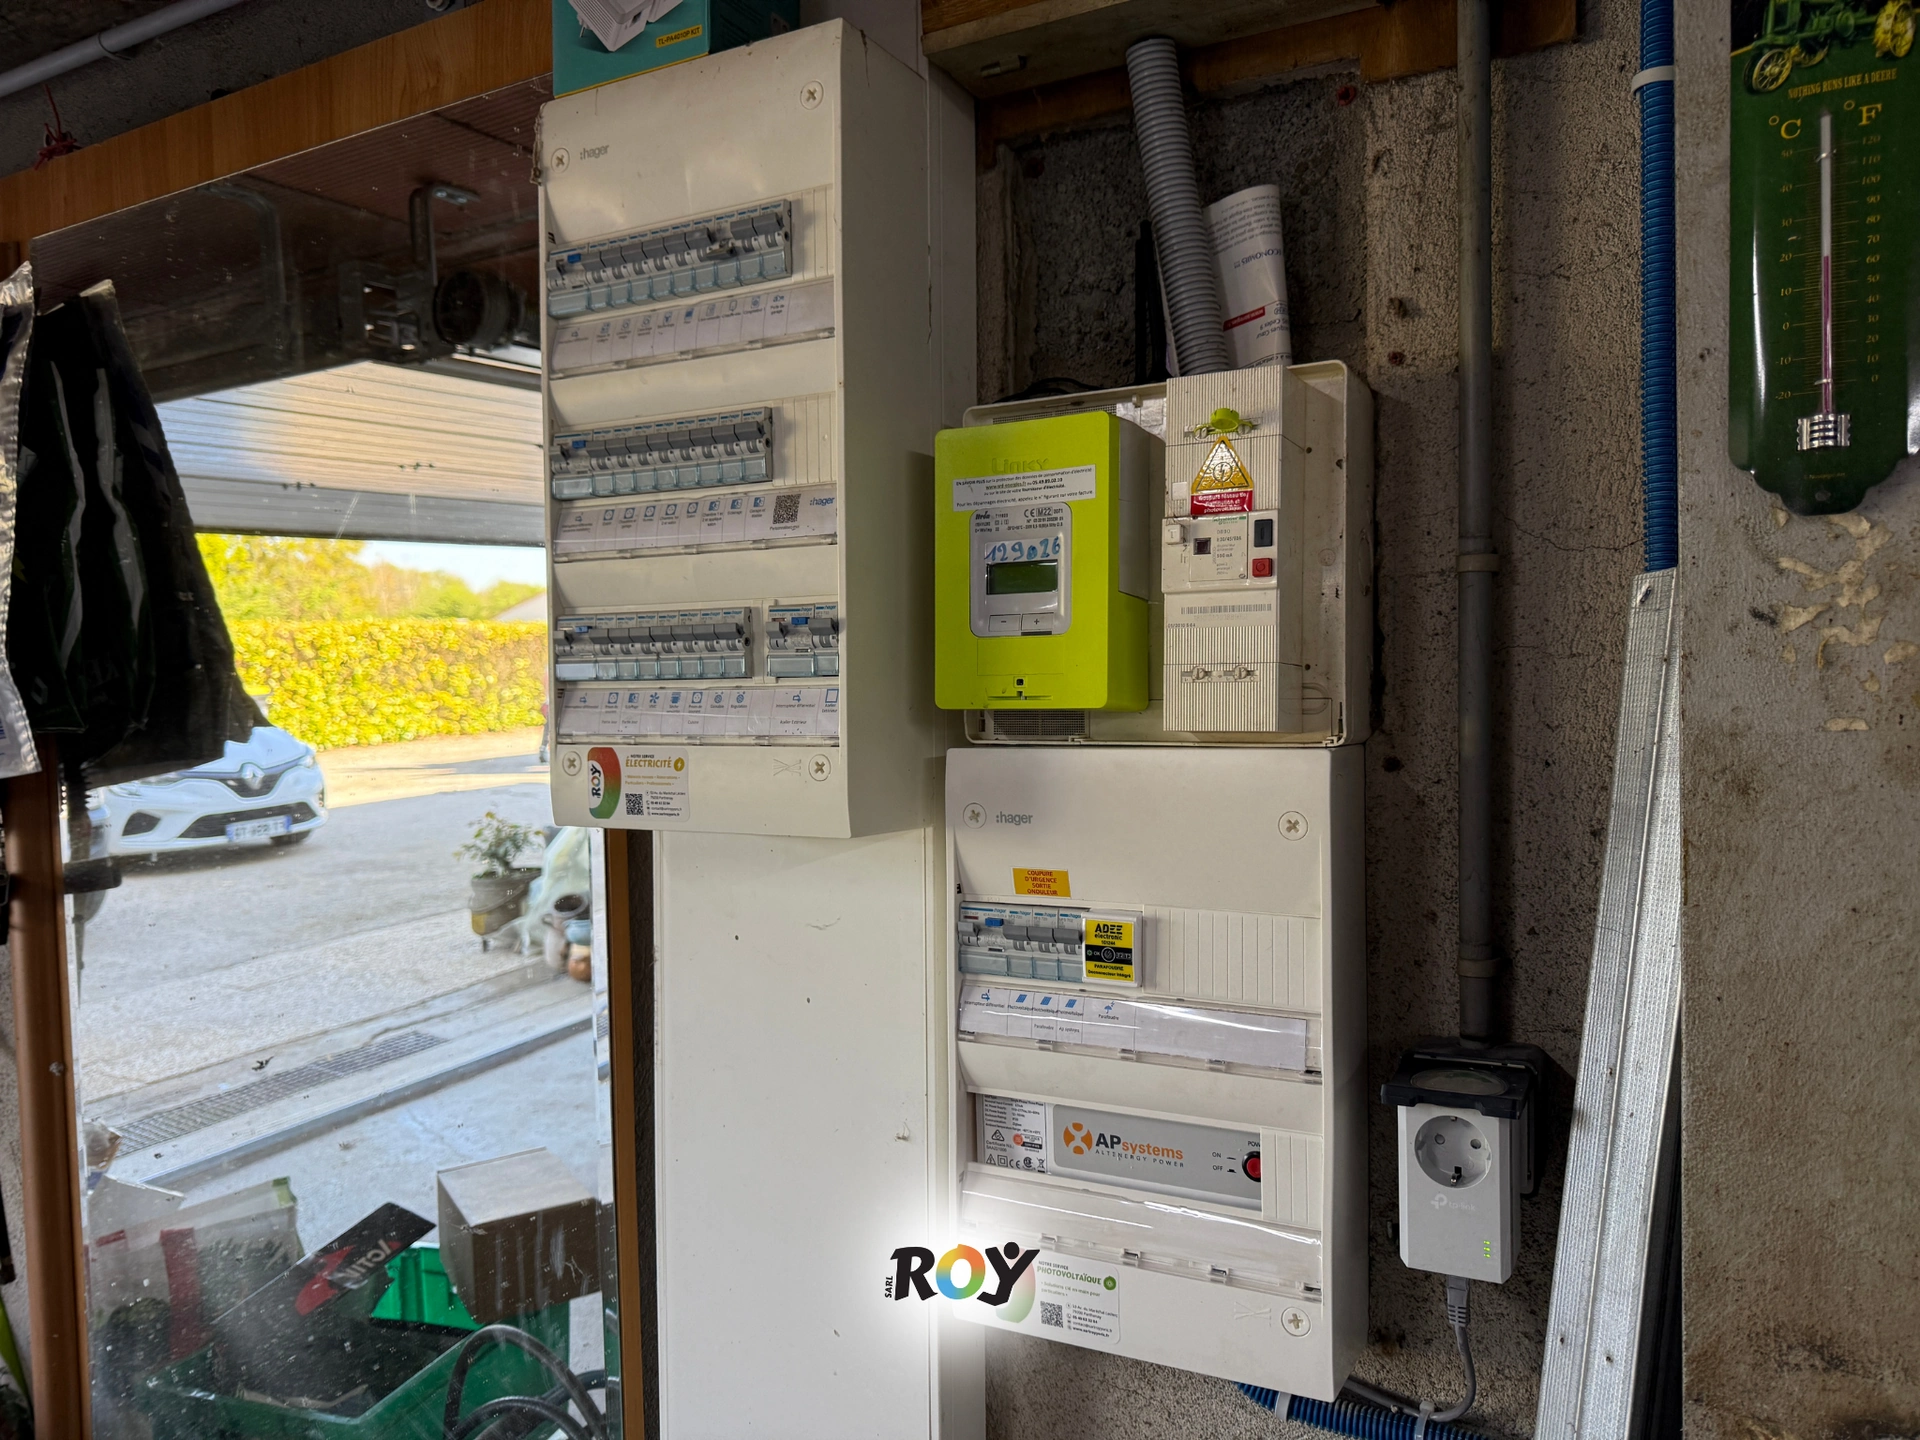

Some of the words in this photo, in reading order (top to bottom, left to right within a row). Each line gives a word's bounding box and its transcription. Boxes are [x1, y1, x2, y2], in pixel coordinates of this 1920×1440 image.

[691, 27, 700, 35] KIT
[1788, 82, 1821, 99] NOTHING
[1822, 78, 1843, 92] RUNS
[1844, 74, 1863, 88] LIKE
[1864, 74, 1869, 84] A
[1871, 68, 1897, 82] DEERE
[1862, 175, 1881, 185] 100
[1866, 195, 1880, 204] 90
[1866, 215, 1880, 224] 80
[1867, 234, 1880, 244] 70
[1241, 249, 1282, 265] CONOMIES
[1780, 253, 1792, 262] 20
[1866, 254, 1880, 263] 60
[1867, 274, 1880, 283] 50
[1780, 287, 1793, 296] 10
[1867, 295, 1880, 303] 40
[1867, 314, 1879, 323] 30
[1783, 322, 1790, 331] 0
[1865, 334, 1879, 343] 20
[1867, 354, 1879, 363] 10
[1871, 374, 1878, 382] 0
[973, 499, 996, 507] dépannages
[625, 756, 672, 769] ÉLECTRICITÉ
[1025, 876, 1057, 884] D'URGENCE
[1095, 923, 1123, 935] ADEE
[1094, 933, 1123, 941] electronic
[1095, 1149, 1148, 1162] ALTENERGY
[1152, 1157, 1185, 1168] POWER
[1212, 1151, 1222, 1159] ON
[1212, 1164, 1223, 1172] OFF
[1052, 1262, 1069, 1270] SERVICE
[1037, 1265, 1102, 1285] PHOTOVOLTAÏQUE
